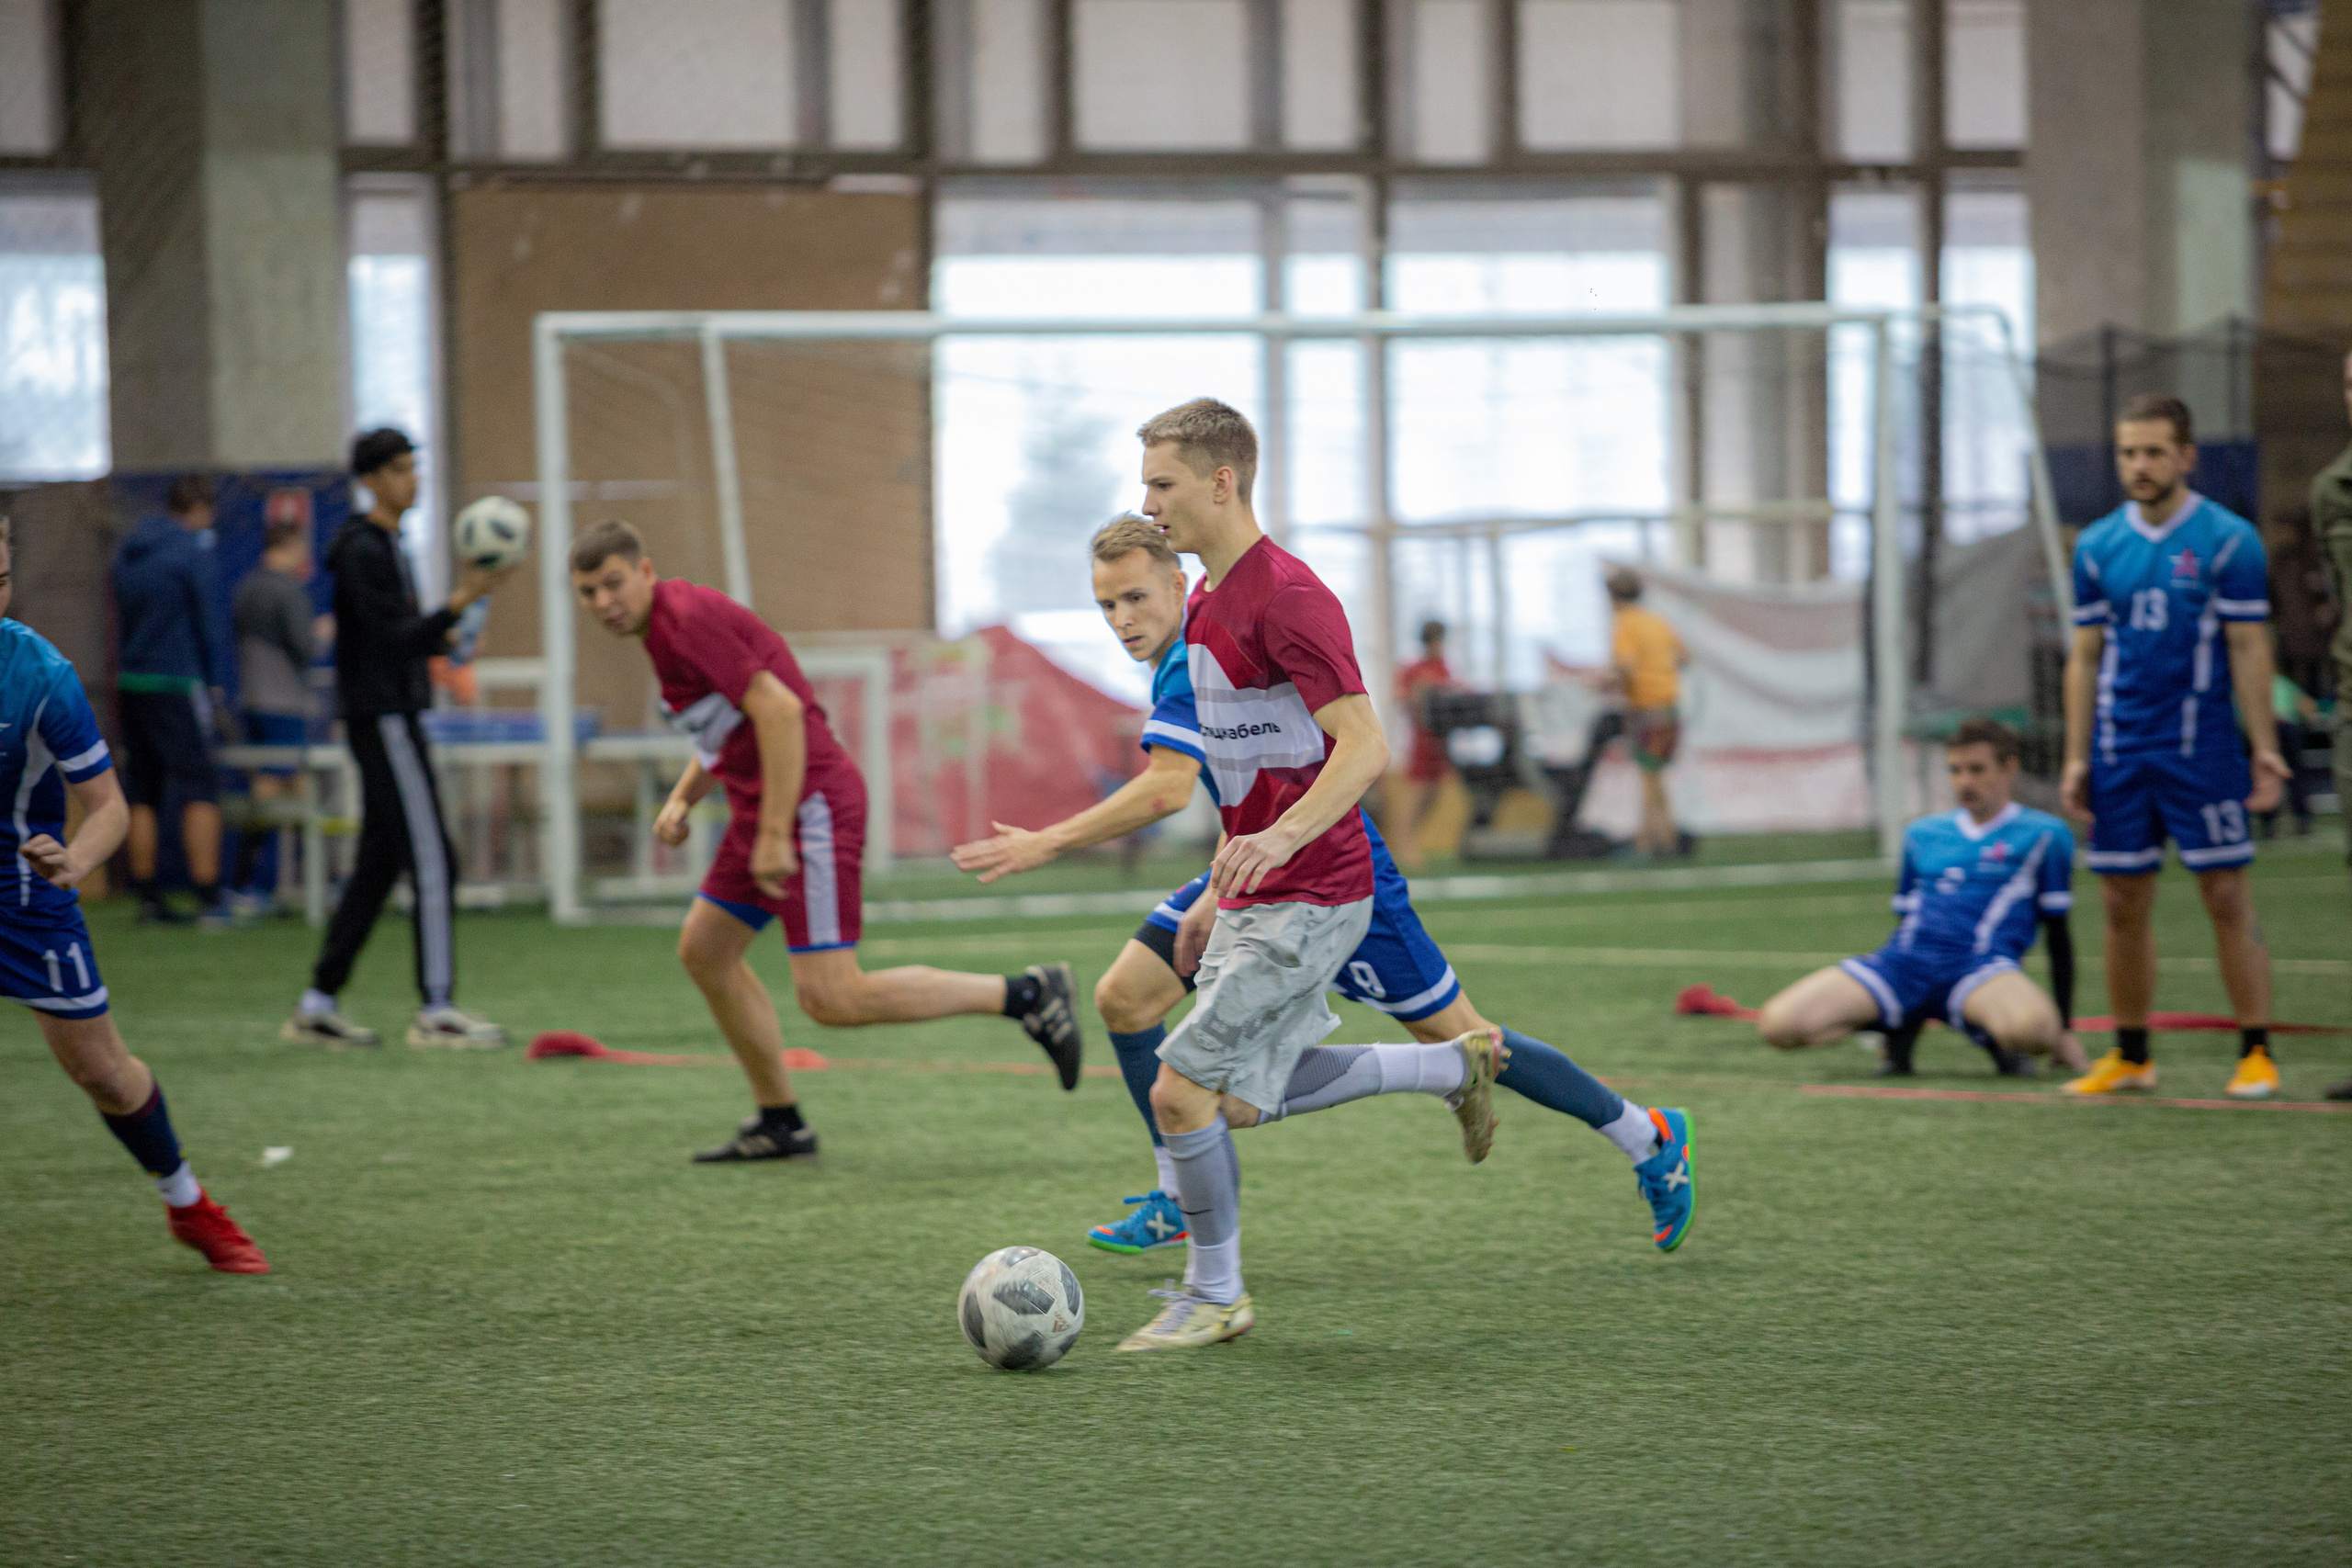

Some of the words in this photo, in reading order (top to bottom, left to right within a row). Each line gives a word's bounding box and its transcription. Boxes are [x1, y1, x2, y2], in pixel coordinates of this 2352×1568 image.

[2131, 588, 2168, 630] 13
[2200, 800, 2245, 843] 13
[42, 942, 91, 992] 11
